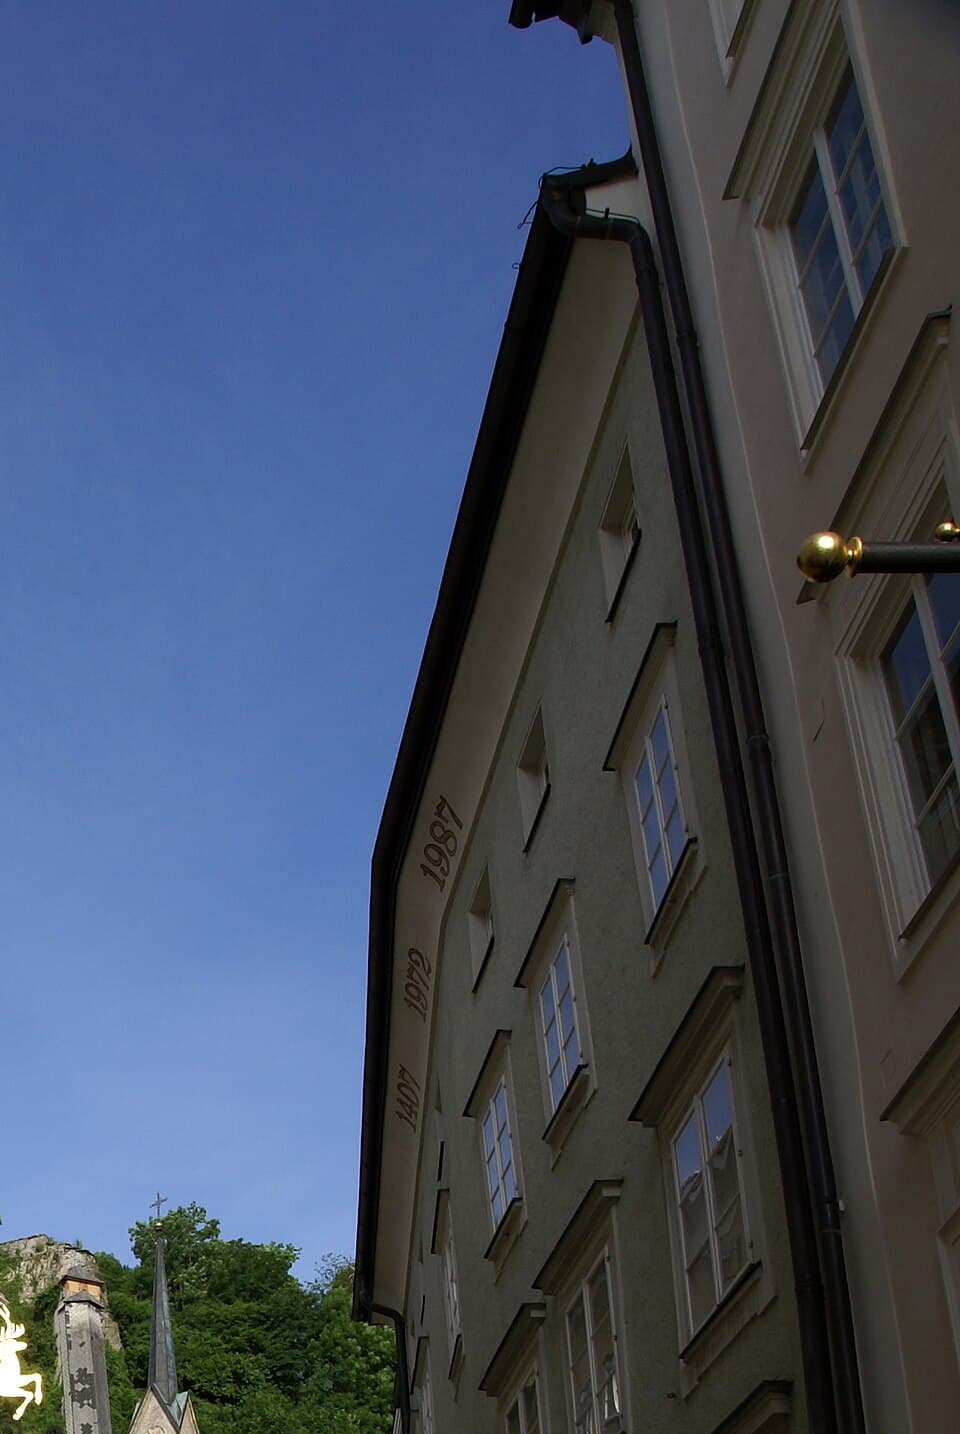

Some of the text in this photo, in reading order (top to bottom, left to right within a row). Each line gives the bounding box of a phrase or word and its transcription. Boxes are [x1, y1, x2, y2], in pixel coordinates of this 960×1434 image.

[419, 794, 464, 894] 1987
[403, 947, 433, 1024] 1972
[394, 1063, 422, 1135] 1407
